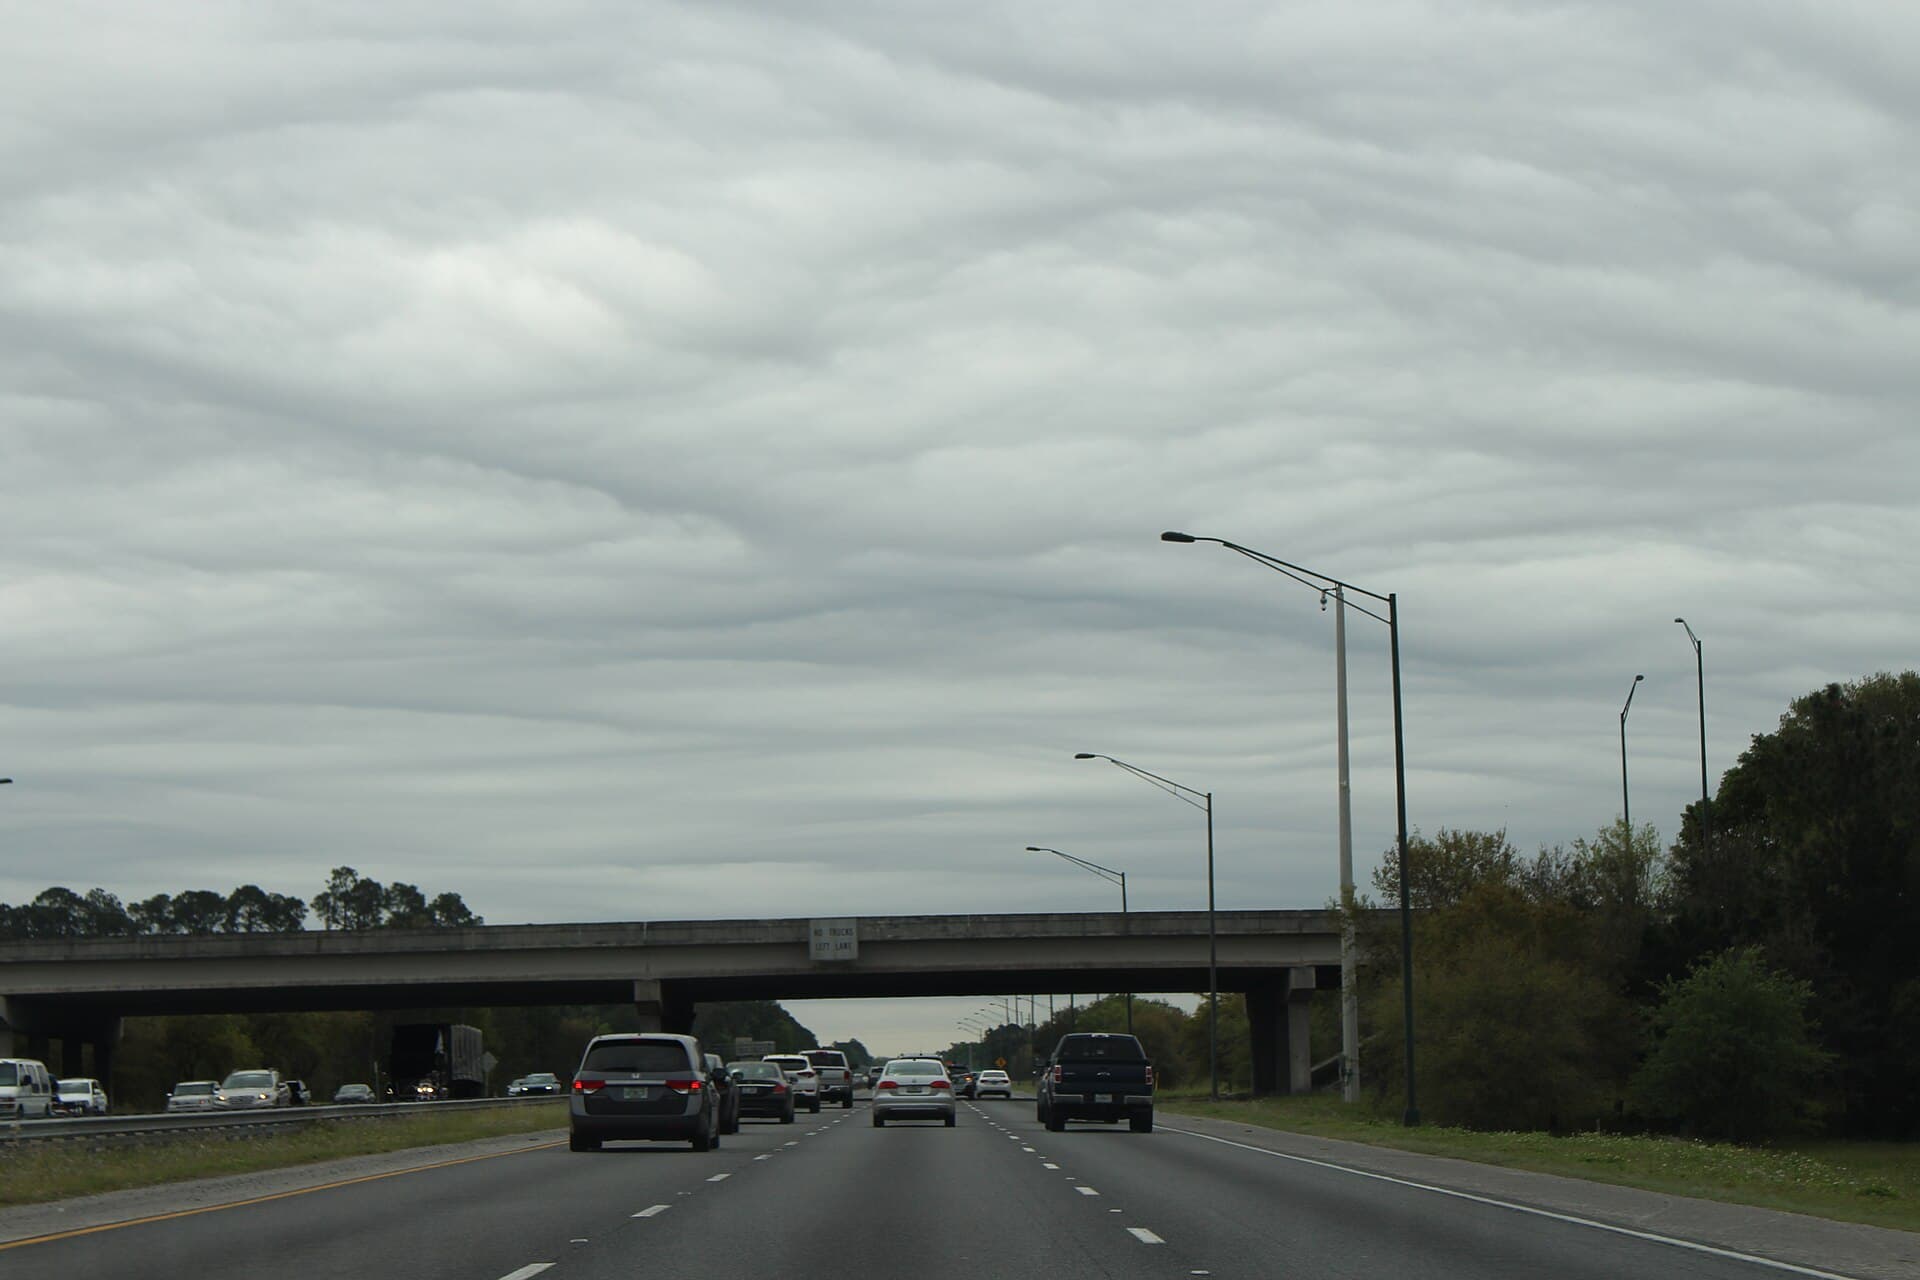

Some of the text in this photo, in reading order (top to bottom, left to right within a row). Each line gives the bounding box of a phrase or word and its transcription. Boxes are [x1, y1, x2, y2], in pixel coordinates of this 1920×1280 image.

[829, 927, 854, 936] TRUCKS
[815, 942, 852, 951] LEFT LANE
